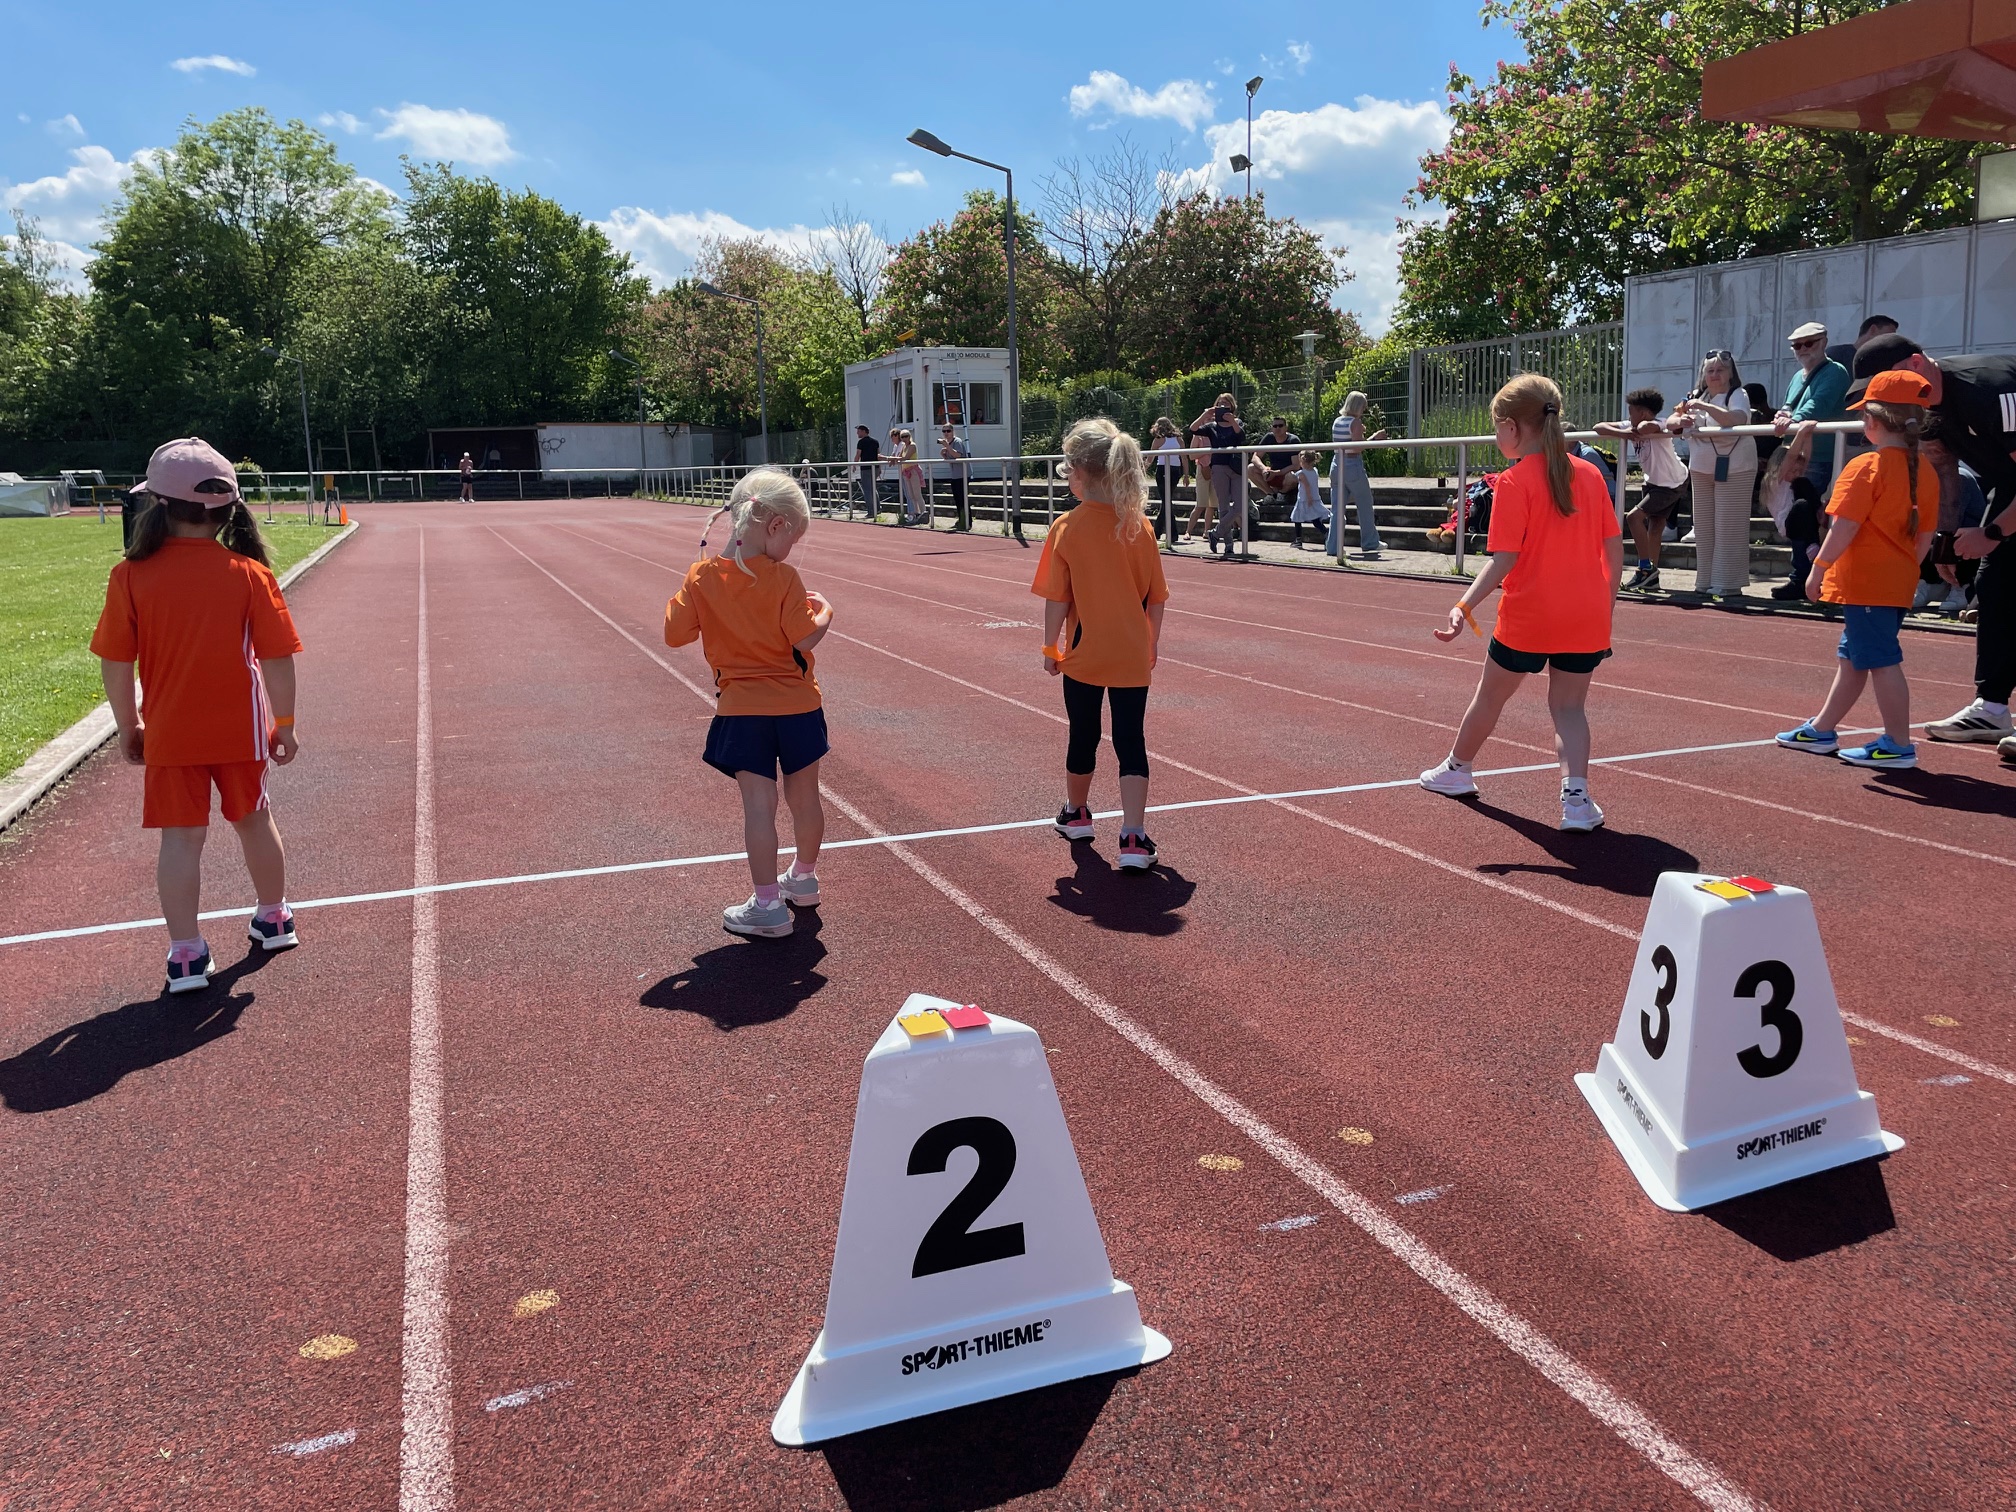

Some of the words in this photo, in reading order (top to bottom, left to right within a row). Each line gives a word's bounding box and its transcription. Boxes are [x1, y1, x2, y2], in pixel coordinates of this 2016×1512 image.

[1640, 944, 1678, 1060] 3
[1733, 959, 1804, 1079] 3
[906, 1116, 1026, 1279] 2
